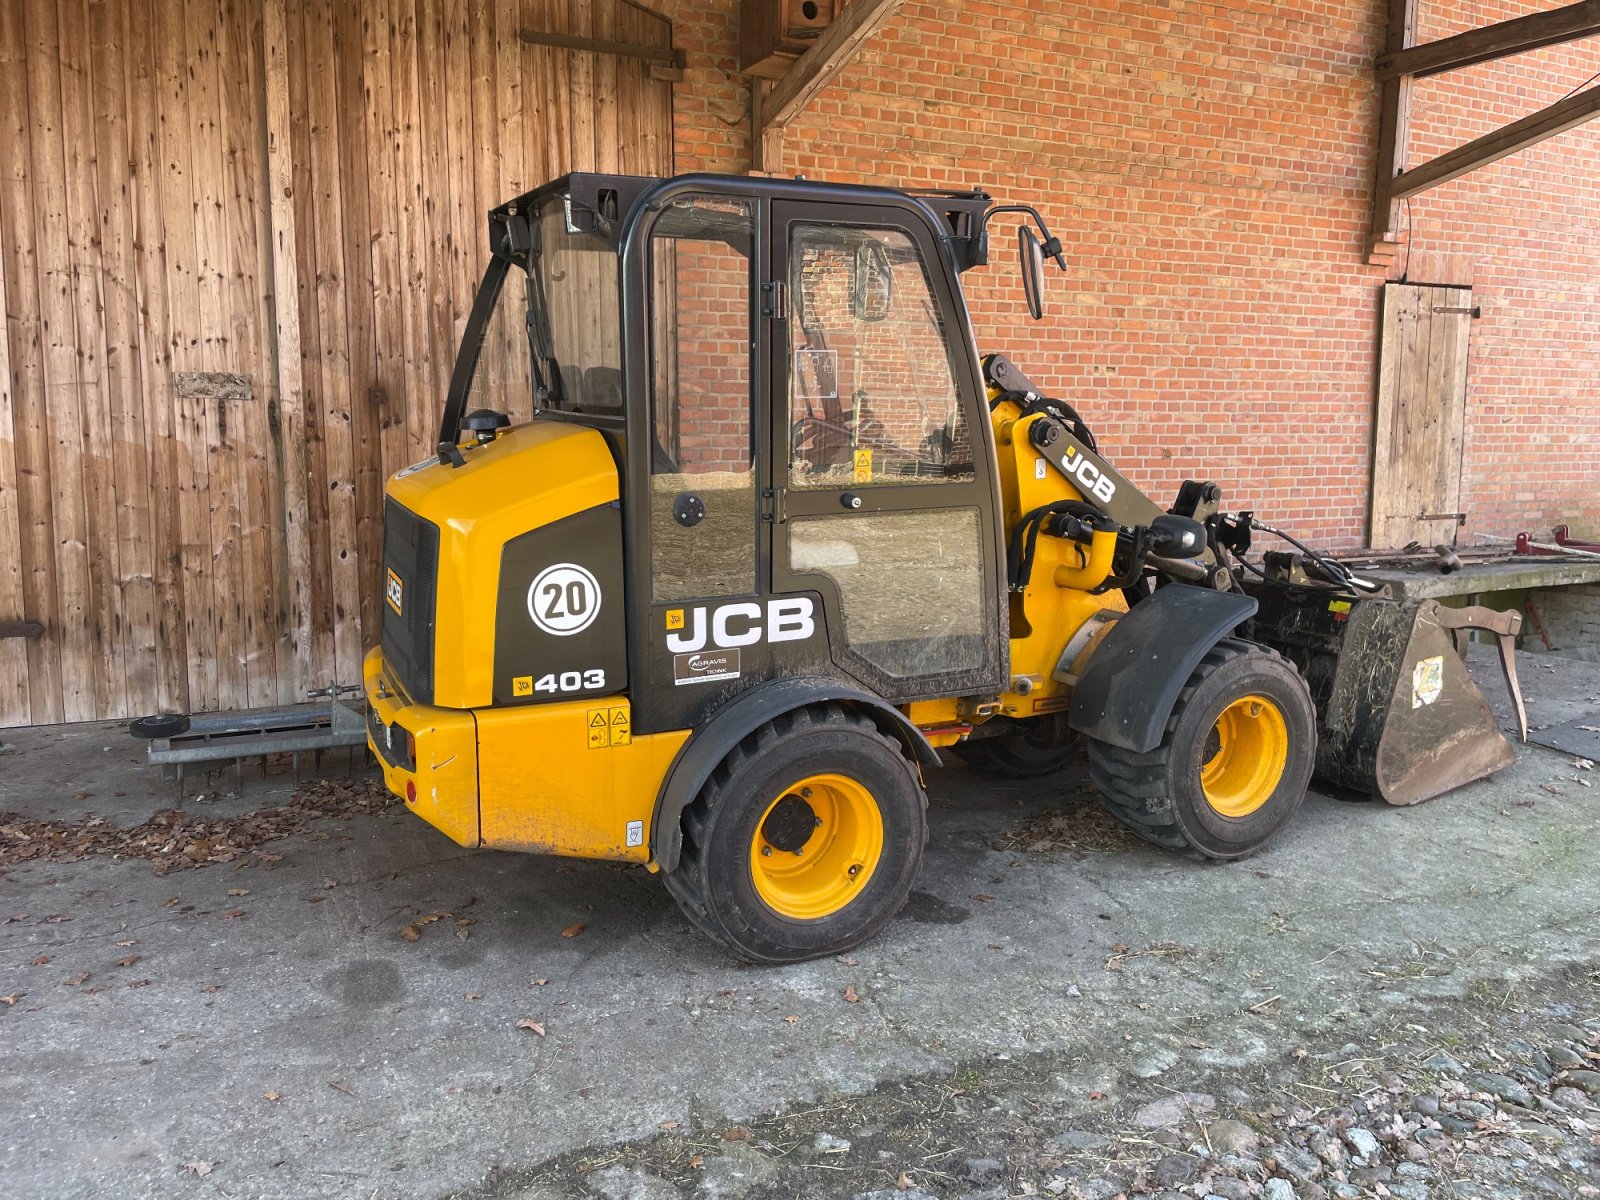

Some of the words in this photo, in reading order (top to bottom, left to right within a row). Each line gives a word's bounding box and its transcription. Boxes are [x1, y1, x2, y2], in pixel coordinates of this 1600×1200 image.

[1061, 453, 1116, 504] JCB
[387, 575, 402, 608] JCB
[542, 580, 587, 620] 20
[666, 597, 815, 653] JCB
[691, 657, 727, 668] AGRAVIS
[534, 669, 606, 693] 403
